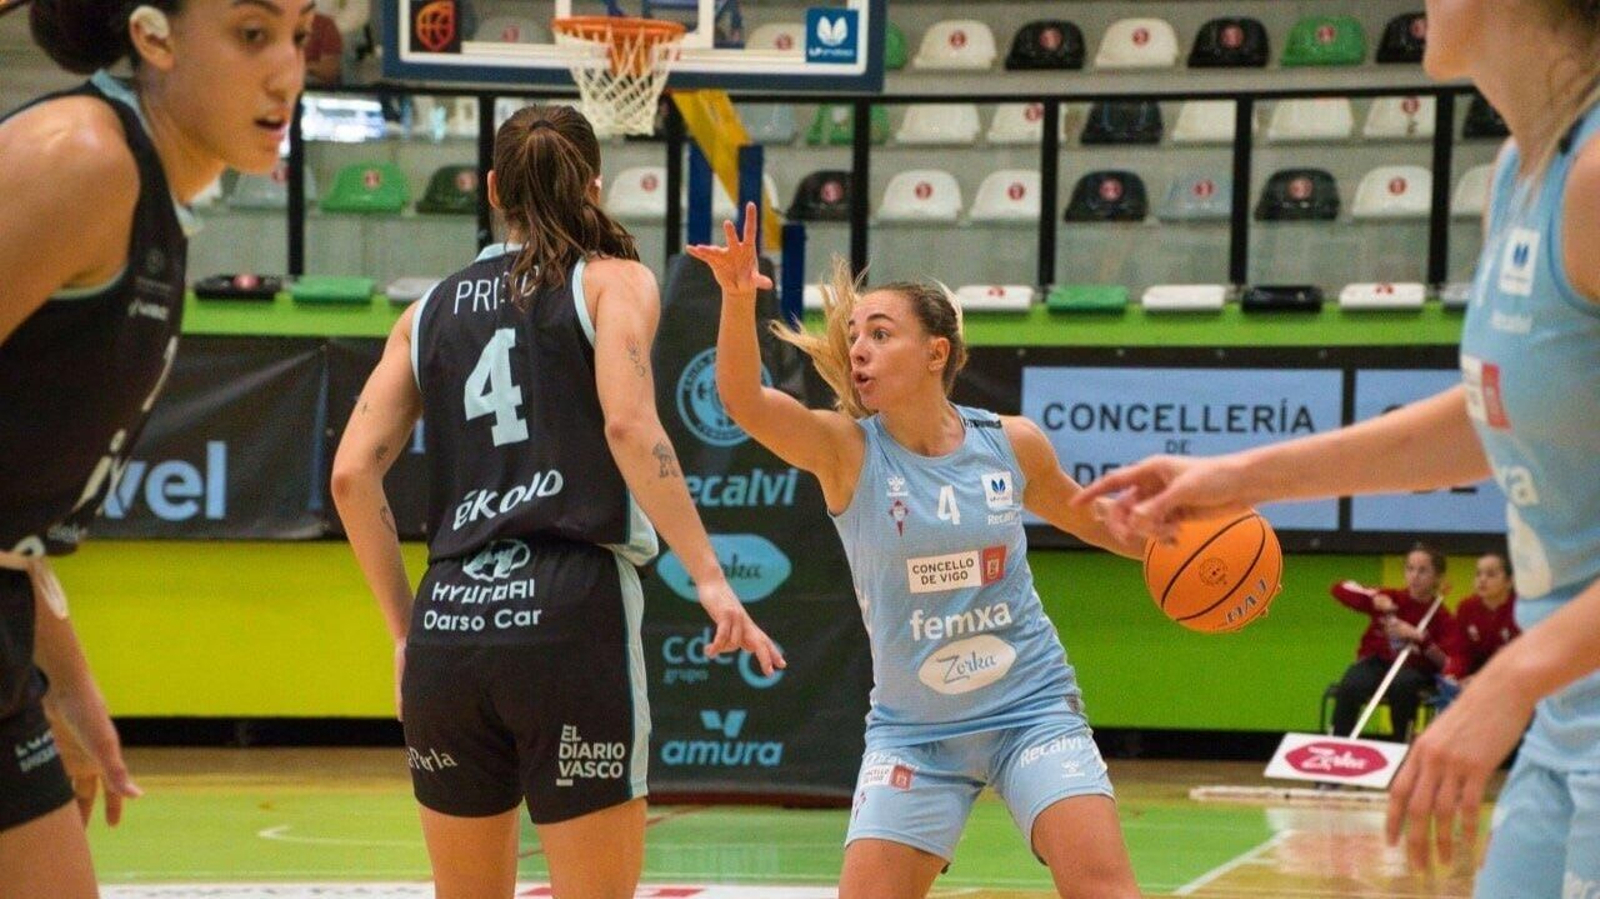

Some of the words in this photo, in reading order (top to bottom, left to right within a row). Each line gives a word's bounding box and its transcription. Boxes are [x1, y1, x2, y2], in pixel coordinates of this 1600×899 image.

[464, 327, 530, 447] 4
[1042, 400, 1315, 433] CONCELLERÍA
[1165, 439, 1191, 454] DE
[685, 468, 798, 507] ecalvi
[937, 484, 961, 525] 4
[912, 557, 975, 575] CONCELLO
[920, 575, 937, 586] DE
[940, 570, 969, 583] VIGO
[424, 610, 486, 632] Darso
[494, 608, 543, 629] Car
[909, 602, 1012, 641] femxa
[936, 650, 998, 685] Zorka
[561, 724, 582, 742] EL
[558, 741, 626, 760] DIARIO
[660, 740, 784, 767] amura
[558, 761, 624, 780] VASCO
